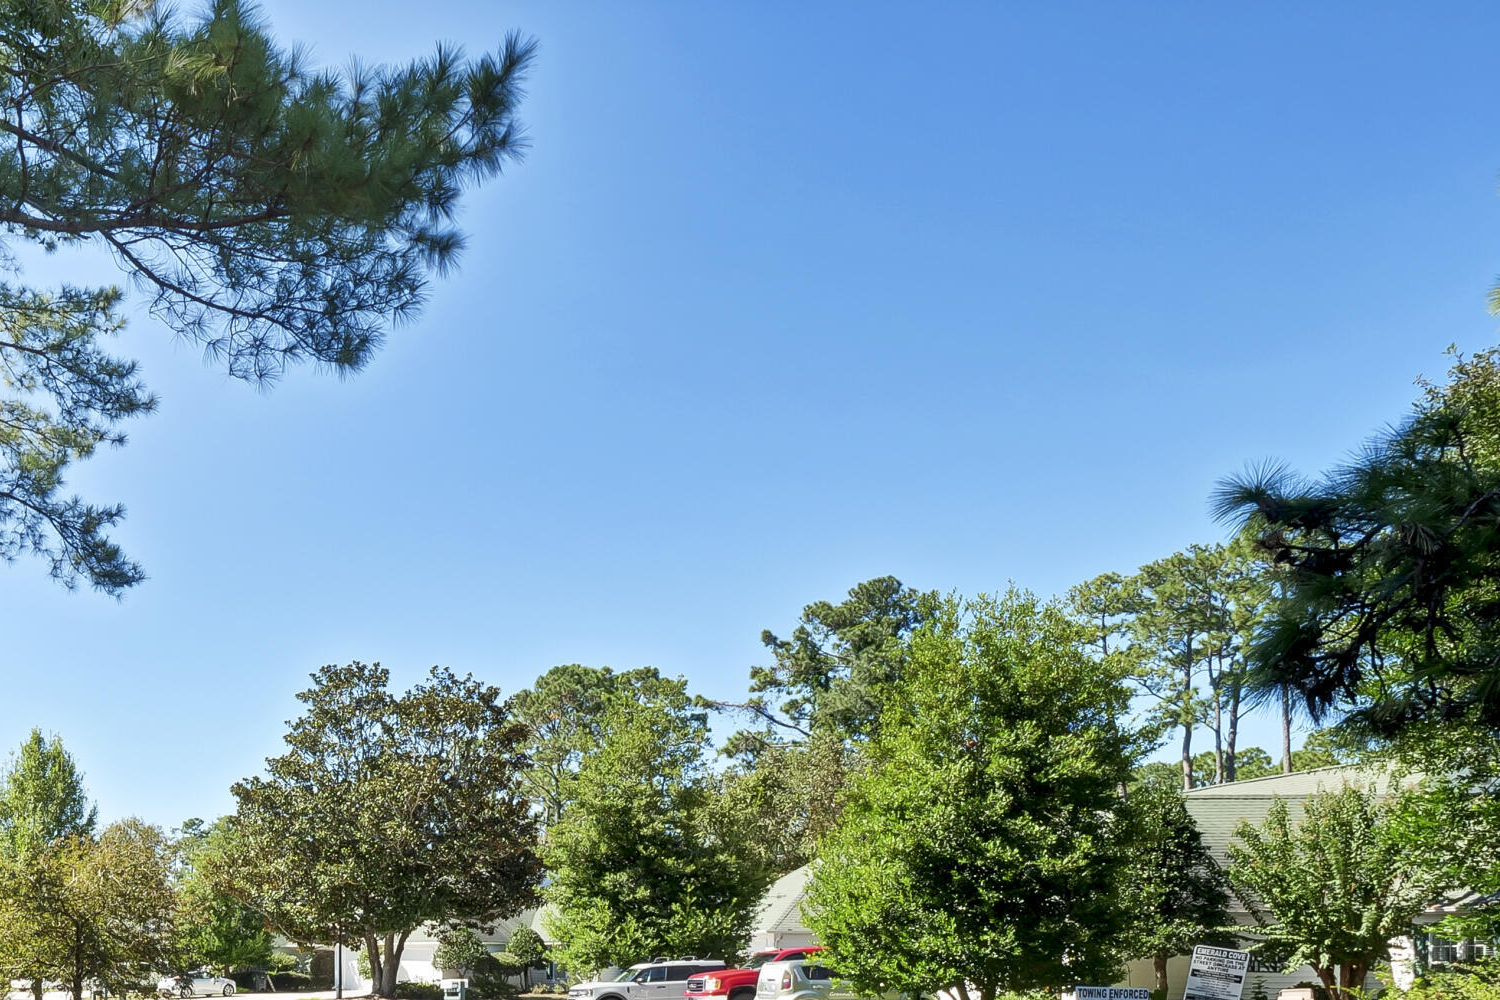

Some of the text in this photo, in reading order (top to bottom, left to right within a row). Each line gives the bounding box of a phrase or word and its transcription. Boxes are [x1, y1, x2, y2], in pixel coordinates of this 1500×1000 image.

[1197, 948, 1246, 960] EMERALD COVE
[1078, 988, 1148, 999] TOWING ENFORCED
